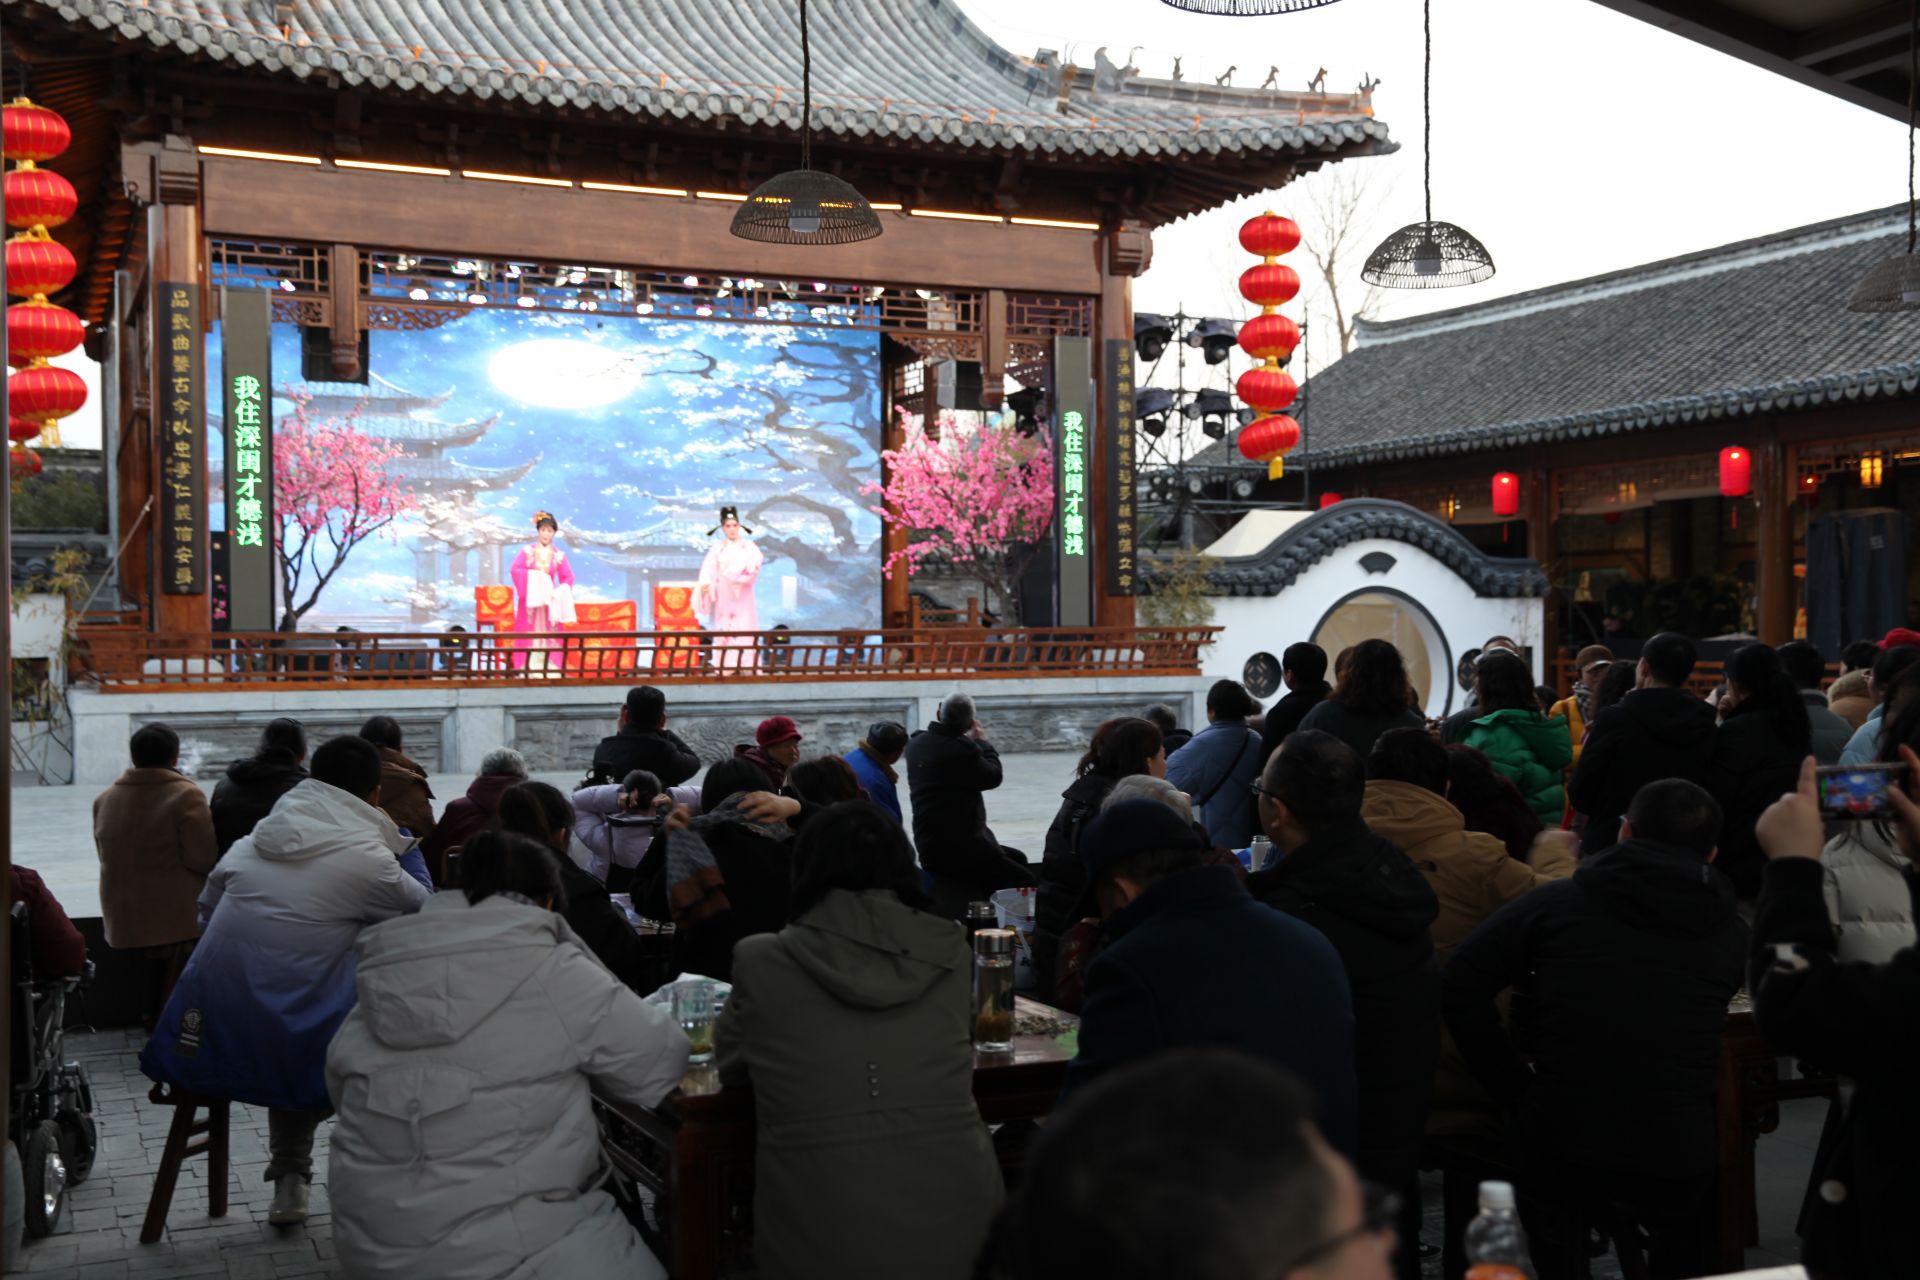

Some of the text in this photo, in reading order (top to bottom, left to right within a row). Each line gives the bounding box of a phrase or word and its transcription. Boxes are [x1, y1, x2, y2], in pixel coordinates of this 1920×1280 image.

[233, 375, 263, 547] 我住深闺才德浅
[1064, 410, 1084, 556] 我住深闺才德浅
